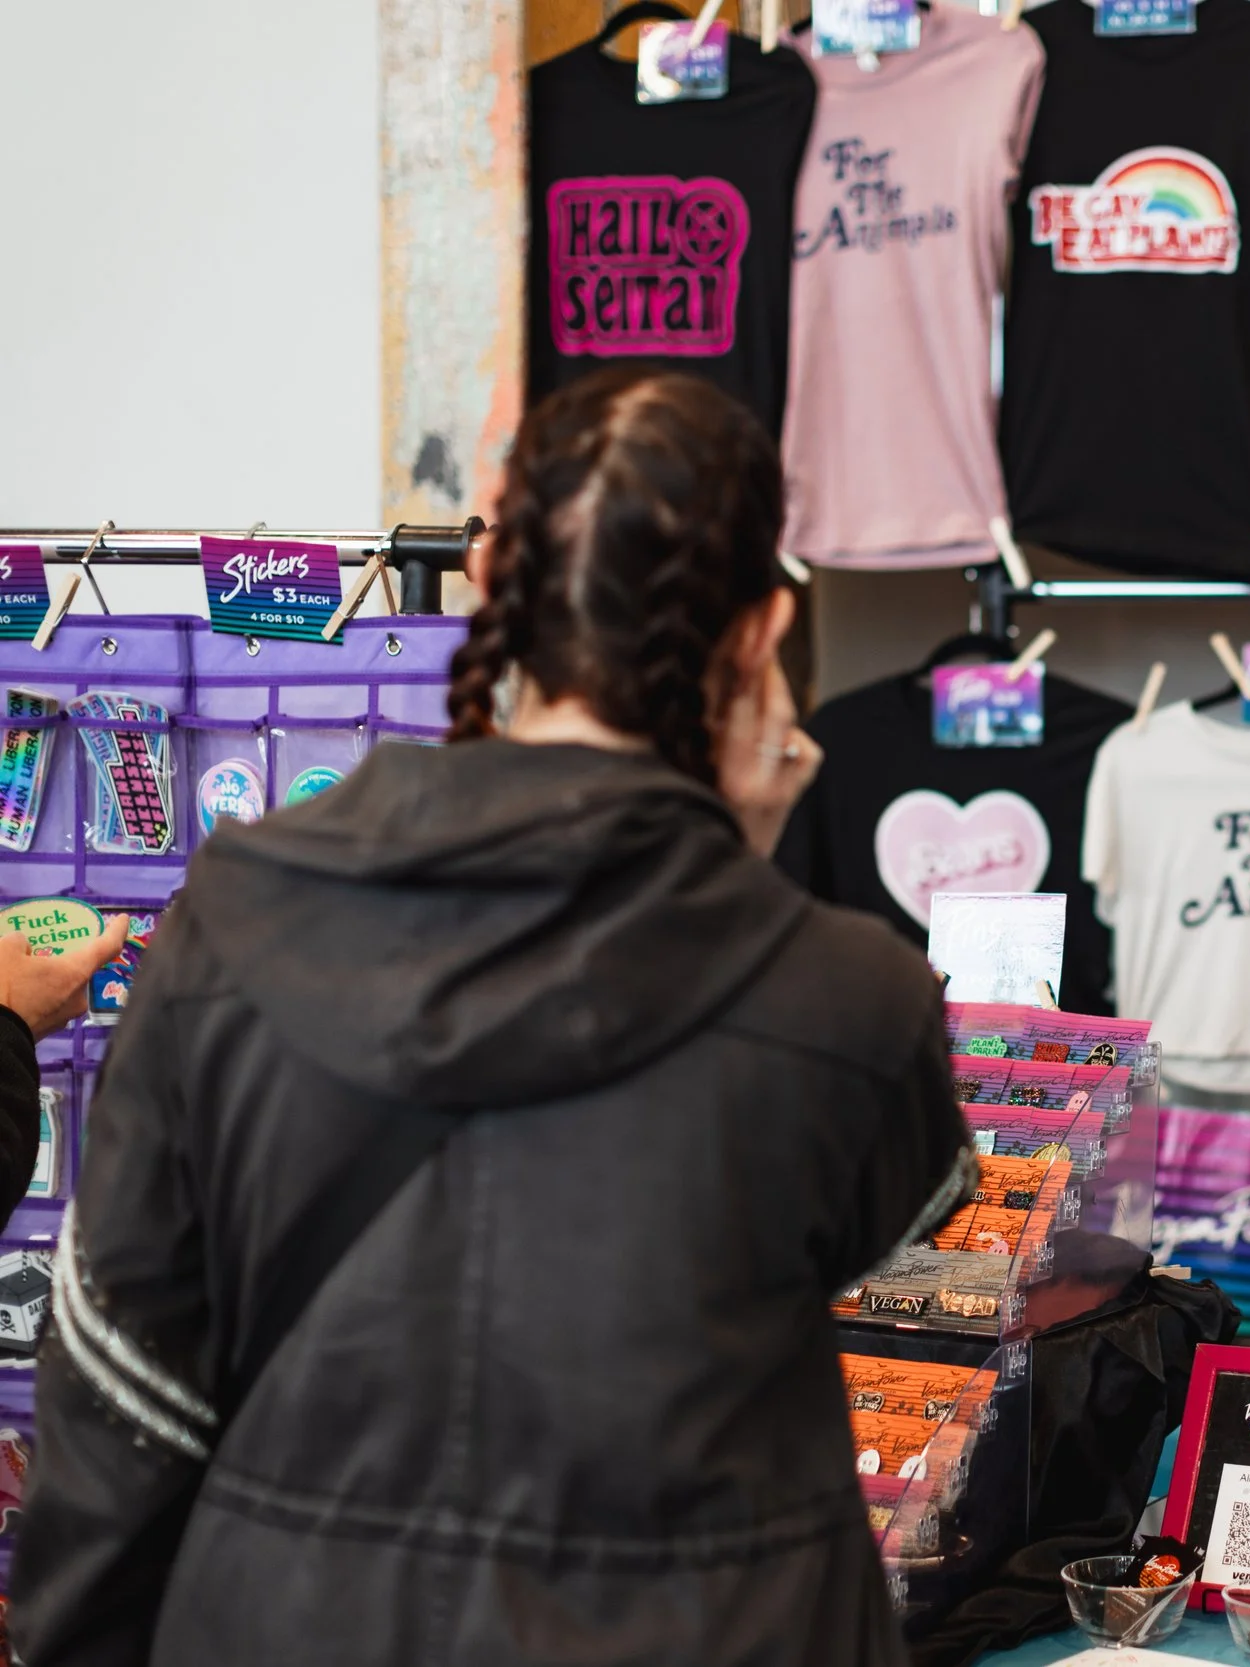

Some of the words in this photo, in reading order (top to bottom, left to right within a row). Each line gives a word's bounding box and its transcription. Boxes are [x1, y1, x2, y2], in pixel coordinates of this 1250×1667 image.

[822, 136, 894, 181] For
[848, 181, 905, 214] The
[792, 205, 958, 259] Animals
[219, 548, 310, 604] Stickers
[4, 594, 37, 604] EACH
[272, 586, 298, 604] $3
[299, 594, 331, 606] EACH
[250, 612, 258, 622] 4
[259, 613, 283, 624] FOR
[285, 614, 305, 625] $10
[220, 781, 241, 796] NO
[6, 784, 30, 842] HUMAN
[7, 909, 69, 931] Fuck
[27, 926, 91, 947] scism
[870, 1295, 924, 1315] VEGAN
